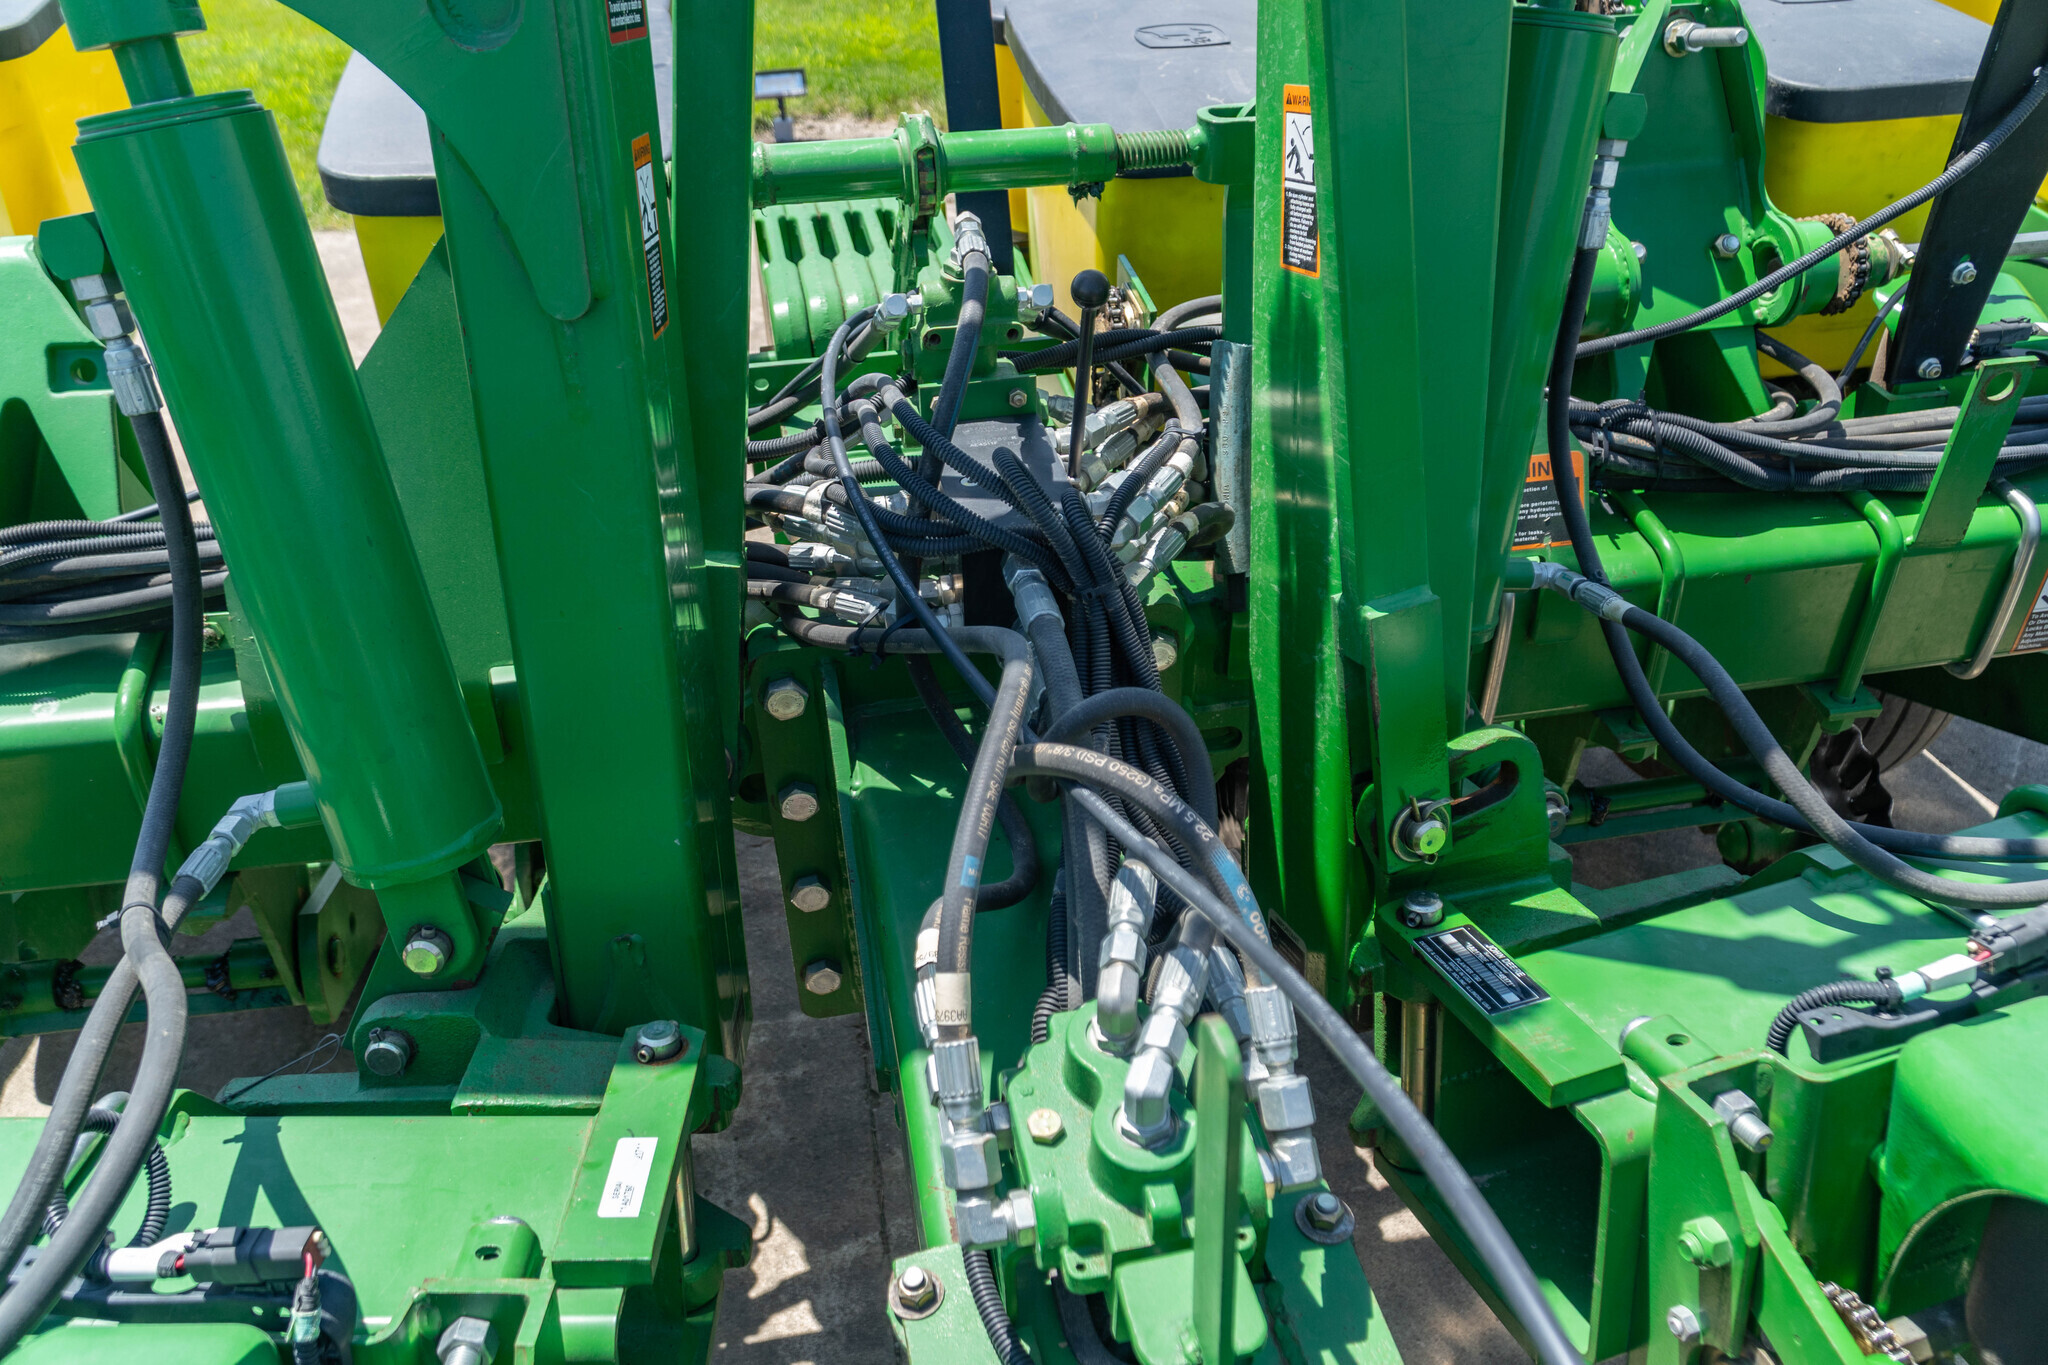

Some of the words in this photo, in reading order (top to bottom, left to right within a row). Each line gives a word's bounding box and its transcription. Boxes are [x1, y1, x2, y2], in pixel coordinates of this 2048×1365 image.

[1047, 745, 1075, 758] 3/8"
[1076, 750, 1108, 768] PSI)
[1108, 760, 1152, 789] (3250
[986, 780, 1000, 801] SAE
[1154, 784, 1185, 814] MPa
[1184, 811, 1214, 842] 22.5
[960, 897, 972, 934] Flame
[1417, 940, 1433, 952] DEERE
[1453, 957, 1474, 974] PLANTER
[1484, 943, 1506, 959] JOHN
[1500, 958, 1526, 977] DEERE
[49, 1130, 66, 1153] USA
